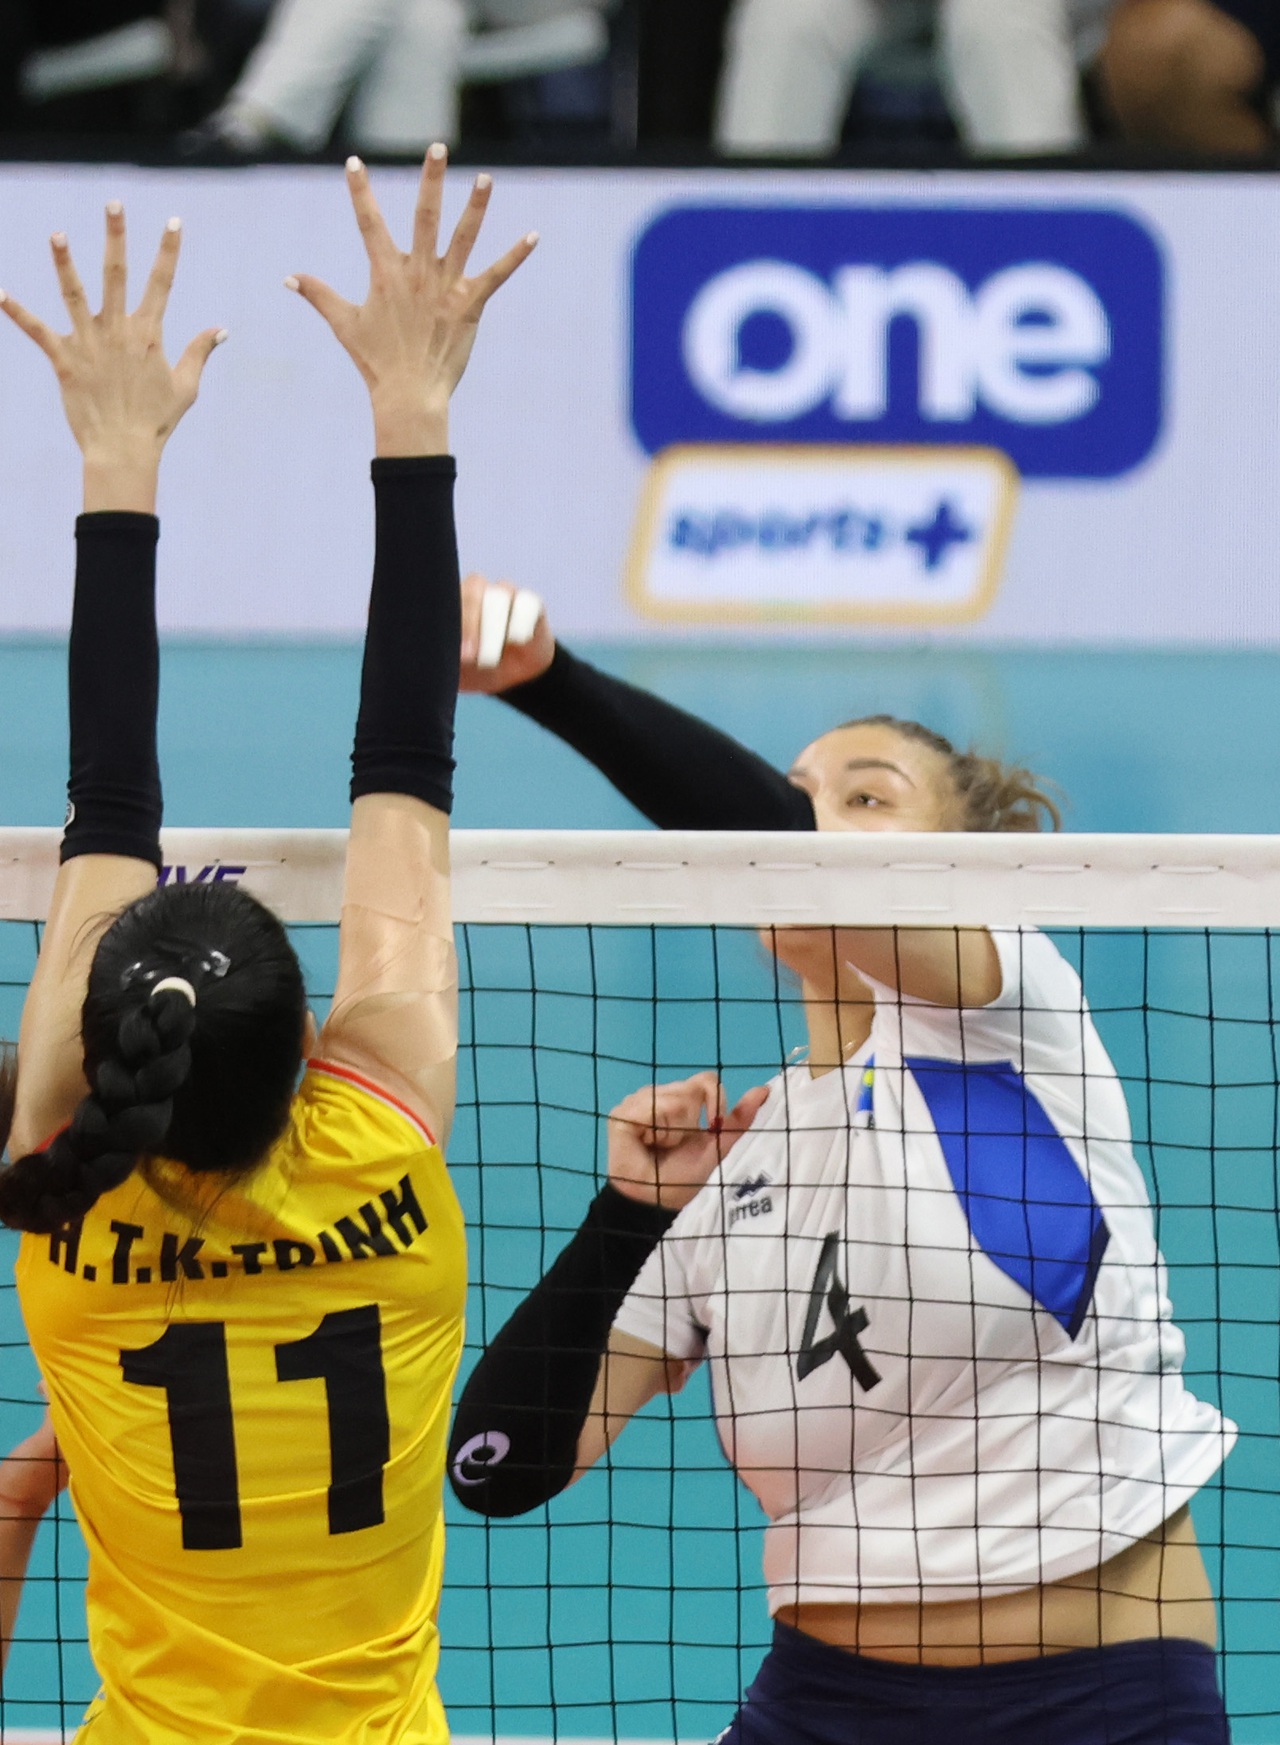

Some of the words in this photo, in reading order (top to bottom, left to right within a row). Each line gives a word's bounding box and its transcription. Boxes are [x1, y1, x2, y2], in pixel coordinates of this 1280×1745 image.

[682, 258, 1112, 425] one
[157, 865, 248, 888] VF
[797, 1230, 882, 1392] 4
[118, 1303, 391, 1551] 11
